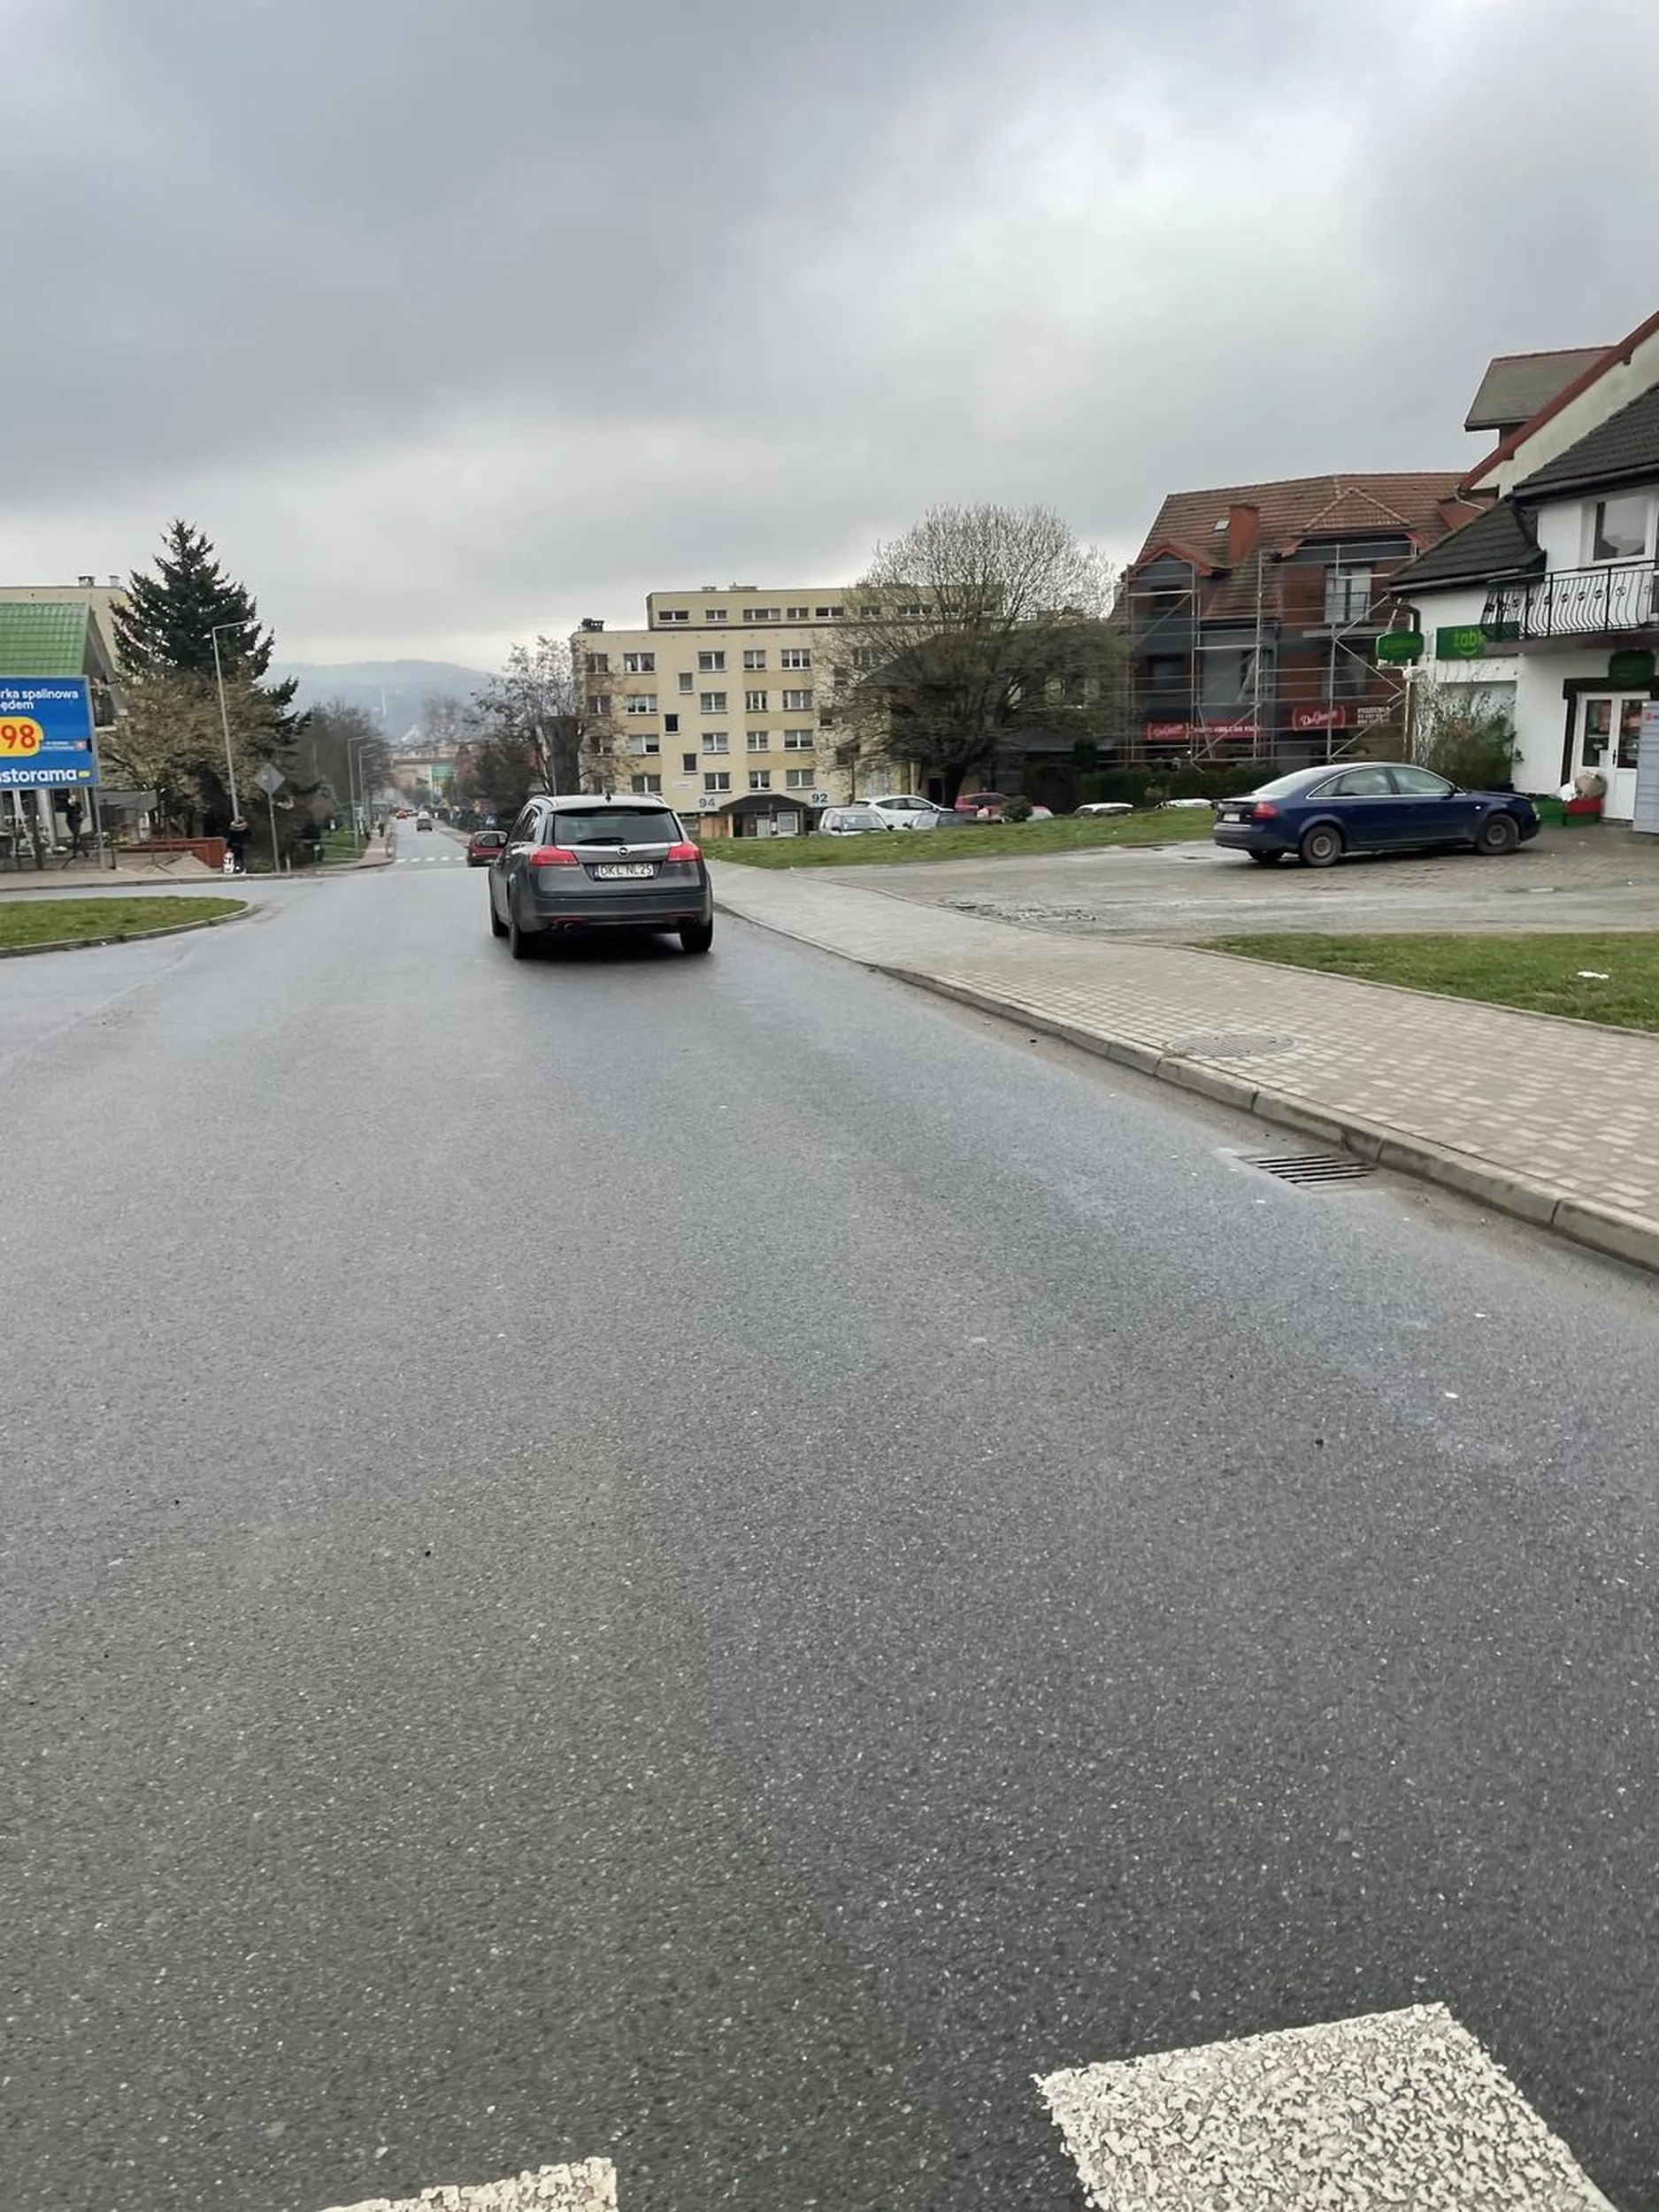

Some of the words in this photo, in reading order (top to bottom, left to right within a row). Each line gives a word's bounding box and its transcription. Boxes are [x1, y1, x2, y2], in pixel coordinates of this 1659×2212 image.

[0, 688, 19, 699] rka
[22, 688, 78, 701] spalinowa
[0, 699, 34, 711] ędem
[2, 725, 35, 749] 98
[698, 798, 715, 808] 94
[811, 794, 828, 803] 92
